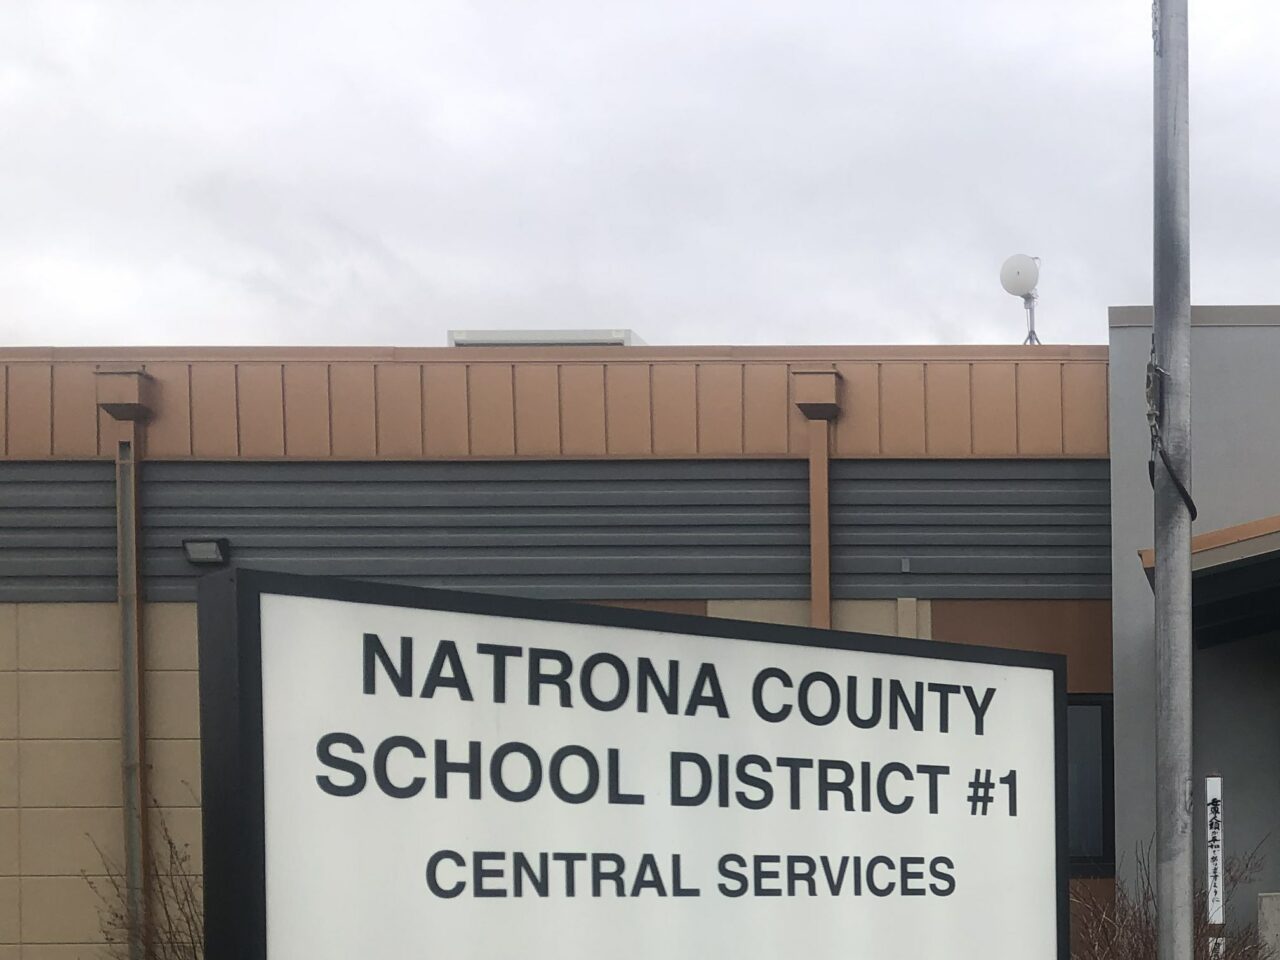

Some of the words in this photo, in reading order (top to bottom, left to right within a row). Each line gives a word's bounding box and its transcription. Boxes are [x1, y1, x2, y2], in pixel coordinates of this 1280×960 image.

[363, 633, 730, 718] NATRONA
[752, 667, 996, 735] COUNTY
[316, 733, 644, 805] SCHOOL
[671, 752, 949, 814] DISTRICT
[967, 769, 1017, 816] #1
[426, 850, 700, 898] CENTRAL
[718, 854, 955, 897] SERVICES
